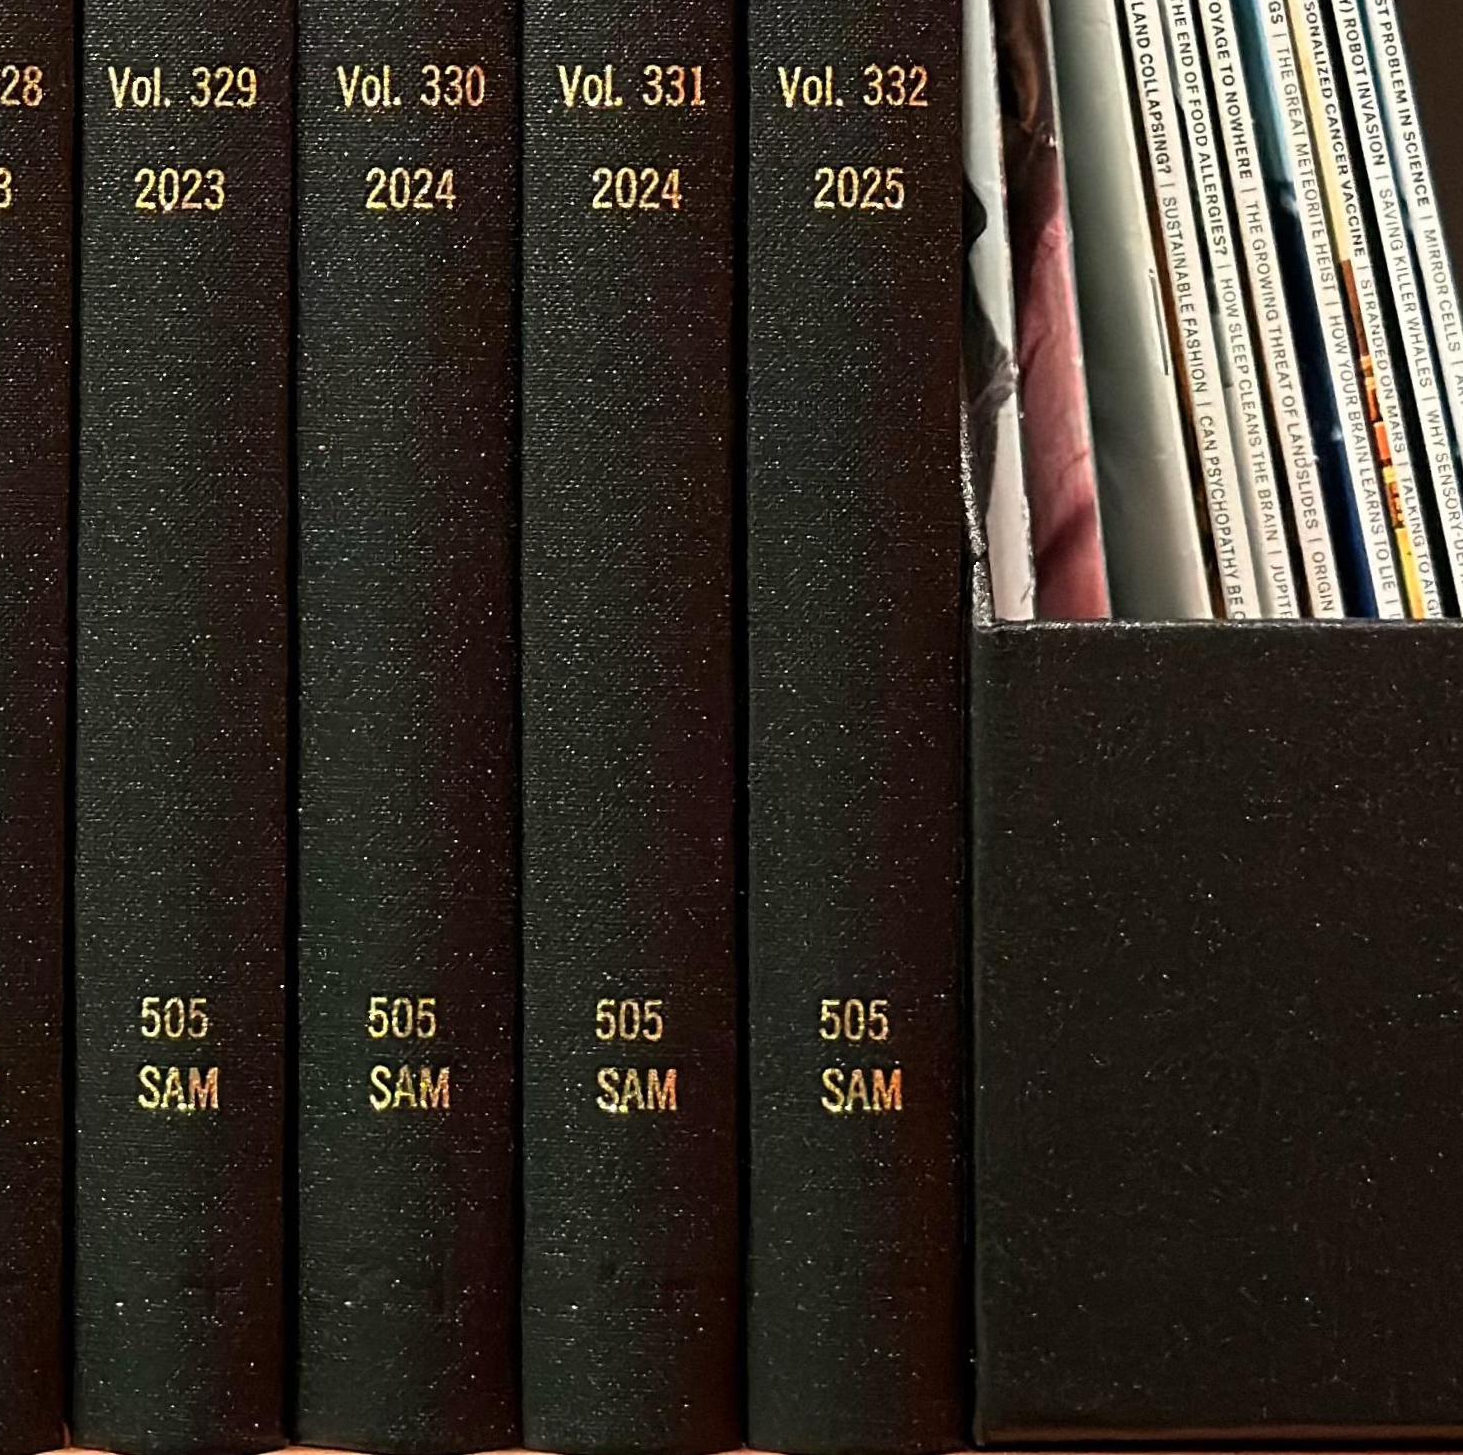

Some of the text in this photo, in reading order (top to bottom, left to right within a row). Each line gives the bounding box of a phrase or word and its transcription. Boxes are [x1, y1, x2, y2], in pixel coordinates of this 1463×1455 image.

[1177, 31, 1194, 67] END
[1277, 47, 1294, 80] THE
[1380, 21, 1408, 104] PROBLEM
[108, 65, 258, 108] Vol. 329
[779, 65, 928, 108] Vol. 332
[1184, 71, 1199, 94] OF
[1219, 63, 1235, 87] TO
[1139, 53, 1173, 174] COLLAPSING?
[1188, 98, 1208, 147] FOOD
[1284, 83, 1306, 136] GREAT
[1398, 108, 1413, 126] IN
[1225, 91, 1253, 179] NOWHERE
[1325, 103, 1349, 176] CANCER
[136, 168, 226, 211] 2023
[822, 167, 905, 210] 2025
[1295, 143, 1325, 239] METEORITE
[1403, 131, 1430, 207] SCIENCE
[1198, 152, 1228, 256] ALLERGIES?
[1245, 201, 1263, 234] THE
[1340, 180, 1365, 257] VACCINE
[1162, 197, 1195, 313] SUSTAINABLE
[1343, 17, 1367, 76] ROBOT
[1356, 81, 1386, 166] INVASION
[1379, 189, 1403, 251] SAVING
[1394, 256, 1416, 312] KILLER
[1407, 317, 1432, 388] WHALES
[1427, 410, 1445, 447] WHY
[1252, 239, 1279, 322] GROWING
[1314, 243, 1336, 290] HEIST
[1424, 229, 1448, 294] MIRROR
[1220, 278, 1239, 317] HOW
[1228, 323, 1249, 374] SLEEP
[1329, 315, 1348, 354] HOW
[1361, 279, 1388, 371] STRANDED
[1439, 300, 1460, 352] CELLS
[1182, 318, 1208, 393] FASHION
[1269, 325, 1293, 390] THREAT
[1282, 395, 1298, 416] OF
[1338, 360, 1358, 406] YOUR
[1380, 375, 1394, 400] ON
[1198, 415, 1218, 451] CAN
[1239, 379, 1262, 447] CLEANS
[1387, 405, 1405, 453] MARS
[1348, 411, 1369, 463] BRAIN
[1252, 451, 1268, 483] THE
[1287, 423, 1319, 530] LANDSLIDES
[1205, 456, 1239, 582] PSYCHOPATHY
[1258, 489, 1278, 541] BRAIN
[1360, 468, 1384, 535] LEARNS
[1401, 477, 1425, 547] TALKING
[1374, 541, 1389, 561] TO
[1417, 553, 1429, 573] TO
[1226, 585, 1244, 606] BE
[1379, 565, 1396, 590] LIE
[1422, 579, 1435, 594] AI
[143, 998, 208, 1039] 505
[820, 999, 890, 1041] 505
[139, 1067, 219, 1112] SAM
[822, 1068, 903, 1113] SAM
